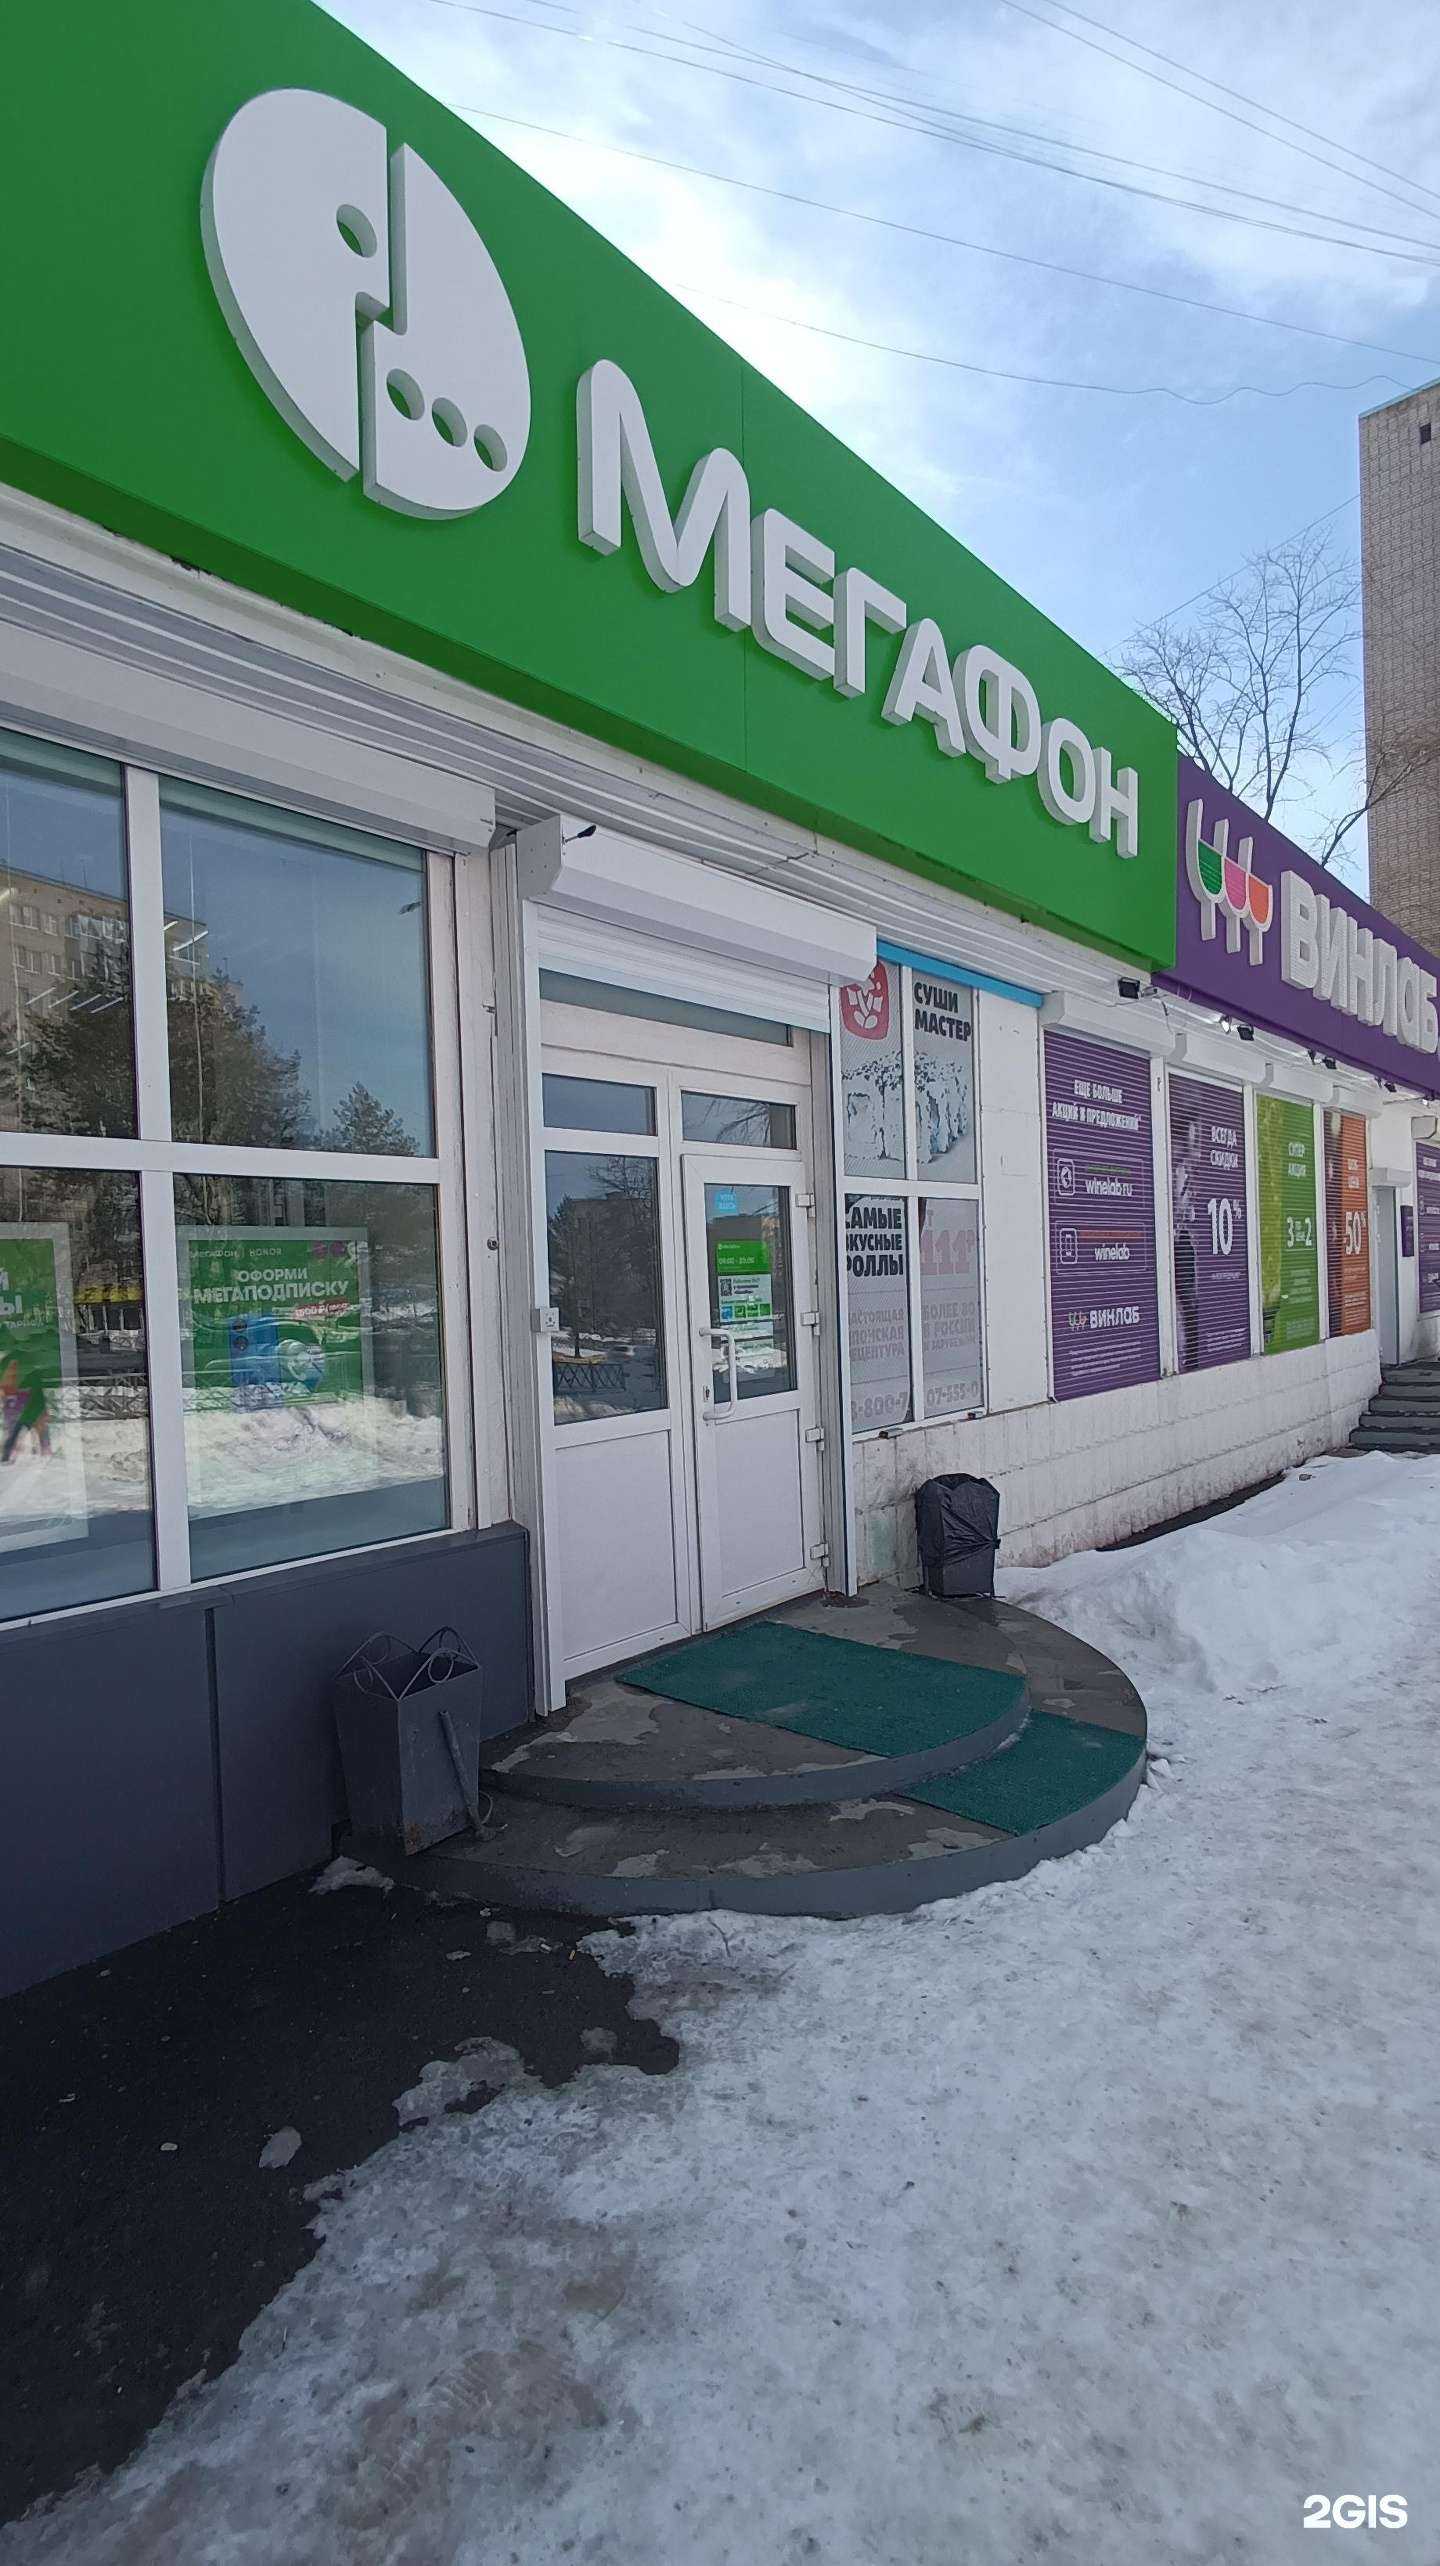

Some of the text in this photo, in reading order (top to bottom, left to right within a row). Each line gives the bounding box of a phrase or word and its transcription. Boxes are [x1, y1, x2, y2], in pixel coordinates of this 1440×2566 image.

[576, 359, 1138, 859] МЕГАФОН
[913, 982, 959, 1013] СУШИ
[914, 1009, 972, 1042] МАСТЕР
[1085, 1177, 1133, 1197] winelab.ru
[846, 1234, 902, 1251] КУСНЫЕ
[1094, 1243, 1130, 1261] winelab
[237, 1267, 308, 1283] ОФОРМИ
[193, 1280, 350, 1305] МЕГАПОДПИСКУ
[850, 1325, 905, 1346] ПОНСКАЯ
[850, 1342, 905, 1362] ЕЦЕПТУРА
